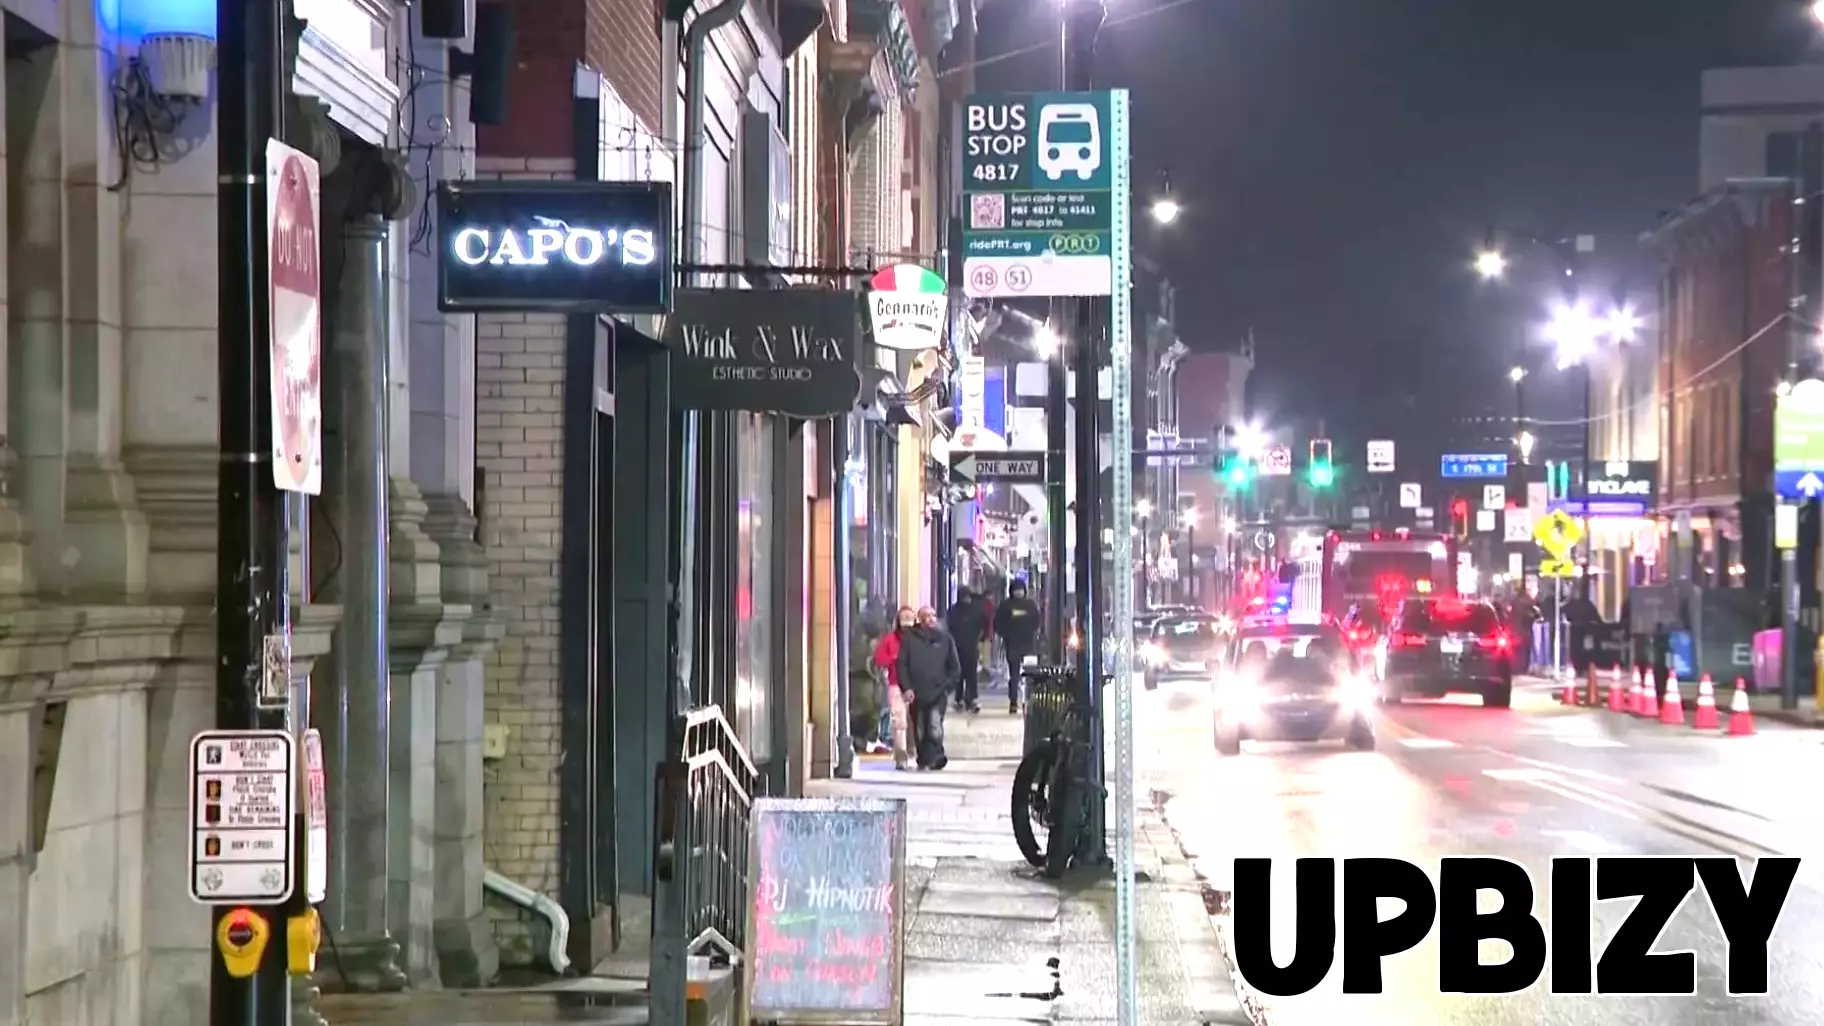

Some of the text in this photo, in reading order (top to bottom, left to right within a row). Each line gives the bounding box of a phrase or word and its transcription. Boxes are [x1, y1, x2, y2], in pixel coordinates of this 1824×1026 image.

[968, 104, 1026, 131] BUS
[968, 135, 1026, 156] STOP
[973, 164, 1019, 180] 4817
[455, 227, 655, 266] CAPO'S
[972, 269, 996, 288] 48
[1008, 269, 1028, 287] 51
[682, 325, 739, 361] Wink
[791, 326, 844, 362] Wax
[770, 368, 812, 382] STUDIO
[976, 461, 1034, 474] ONE WAY
